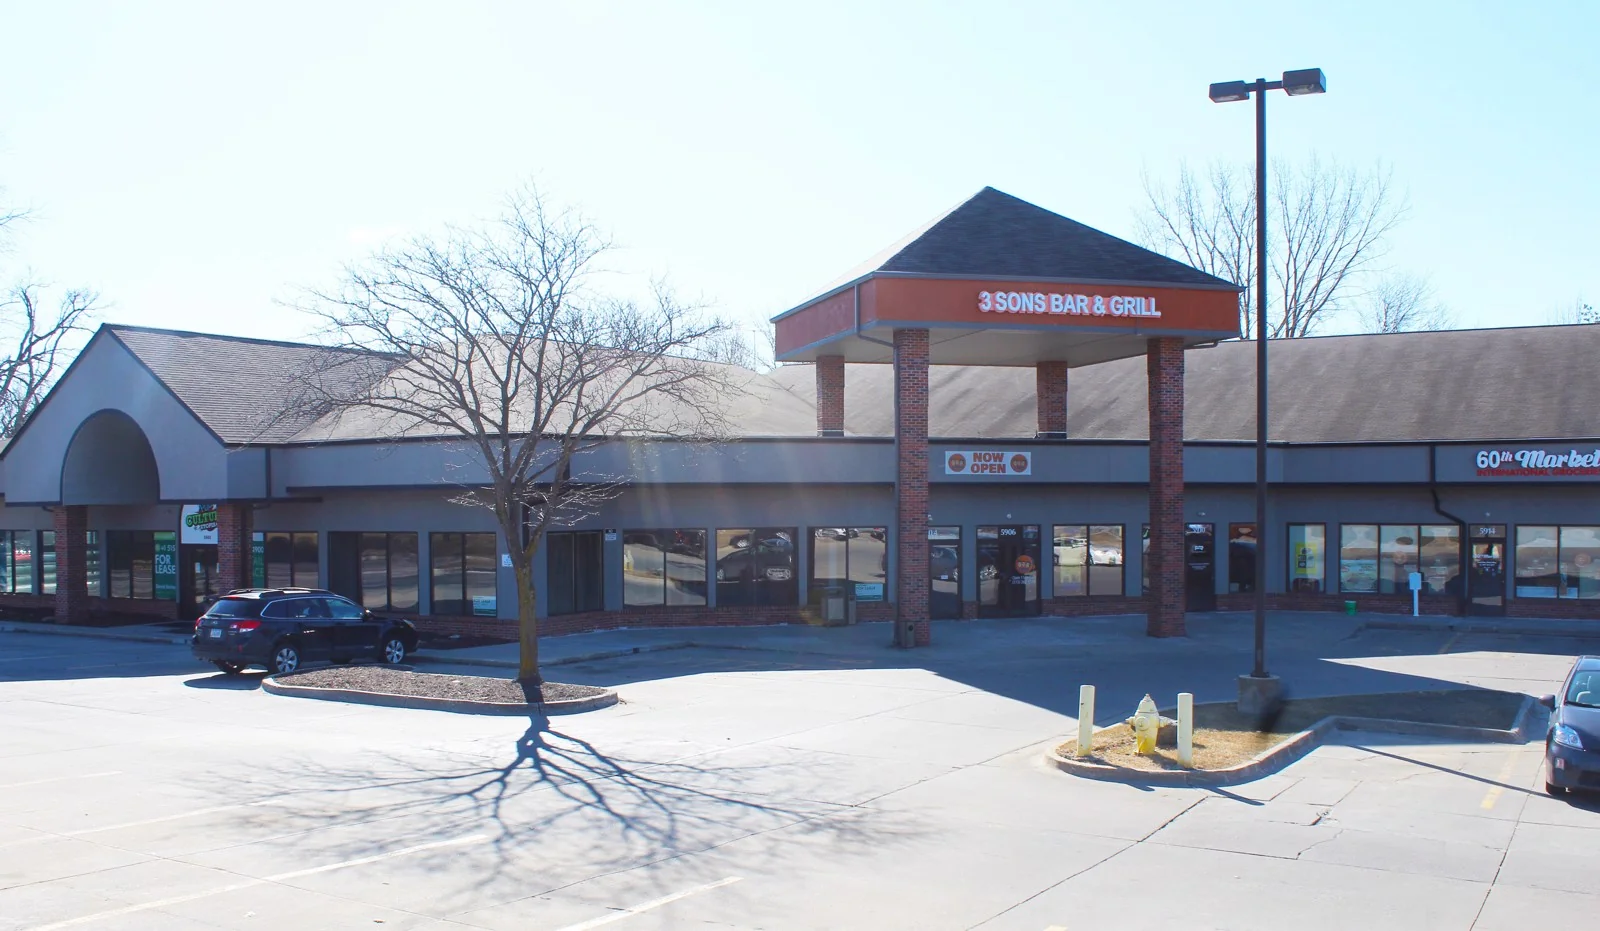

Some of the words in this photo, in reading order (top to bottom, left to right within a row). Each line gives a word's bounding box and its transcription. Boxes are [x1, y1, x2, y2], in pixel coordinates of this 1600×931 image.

[978, 291, 992, 313] 3
[994, 291, 1047, 315] SONS
[1048, 293, 1090, 316] BAR
[1092, 295, 1107, 317] &
[1109, 296, 1162, 318] GRILL
[973, 452, 1005, 463] NOW
[1476, 450, 1513, 469] 60th
[970, 463, 1007, 474] OPEN
[186, 511, 217, 527] CULTU
[1000, 528, 1016, 536] 5906
[1479, 527, 1496, 535] 5914
[155, 554, 171, 564] FOR
[155, 565, 176, 574] LEASE
